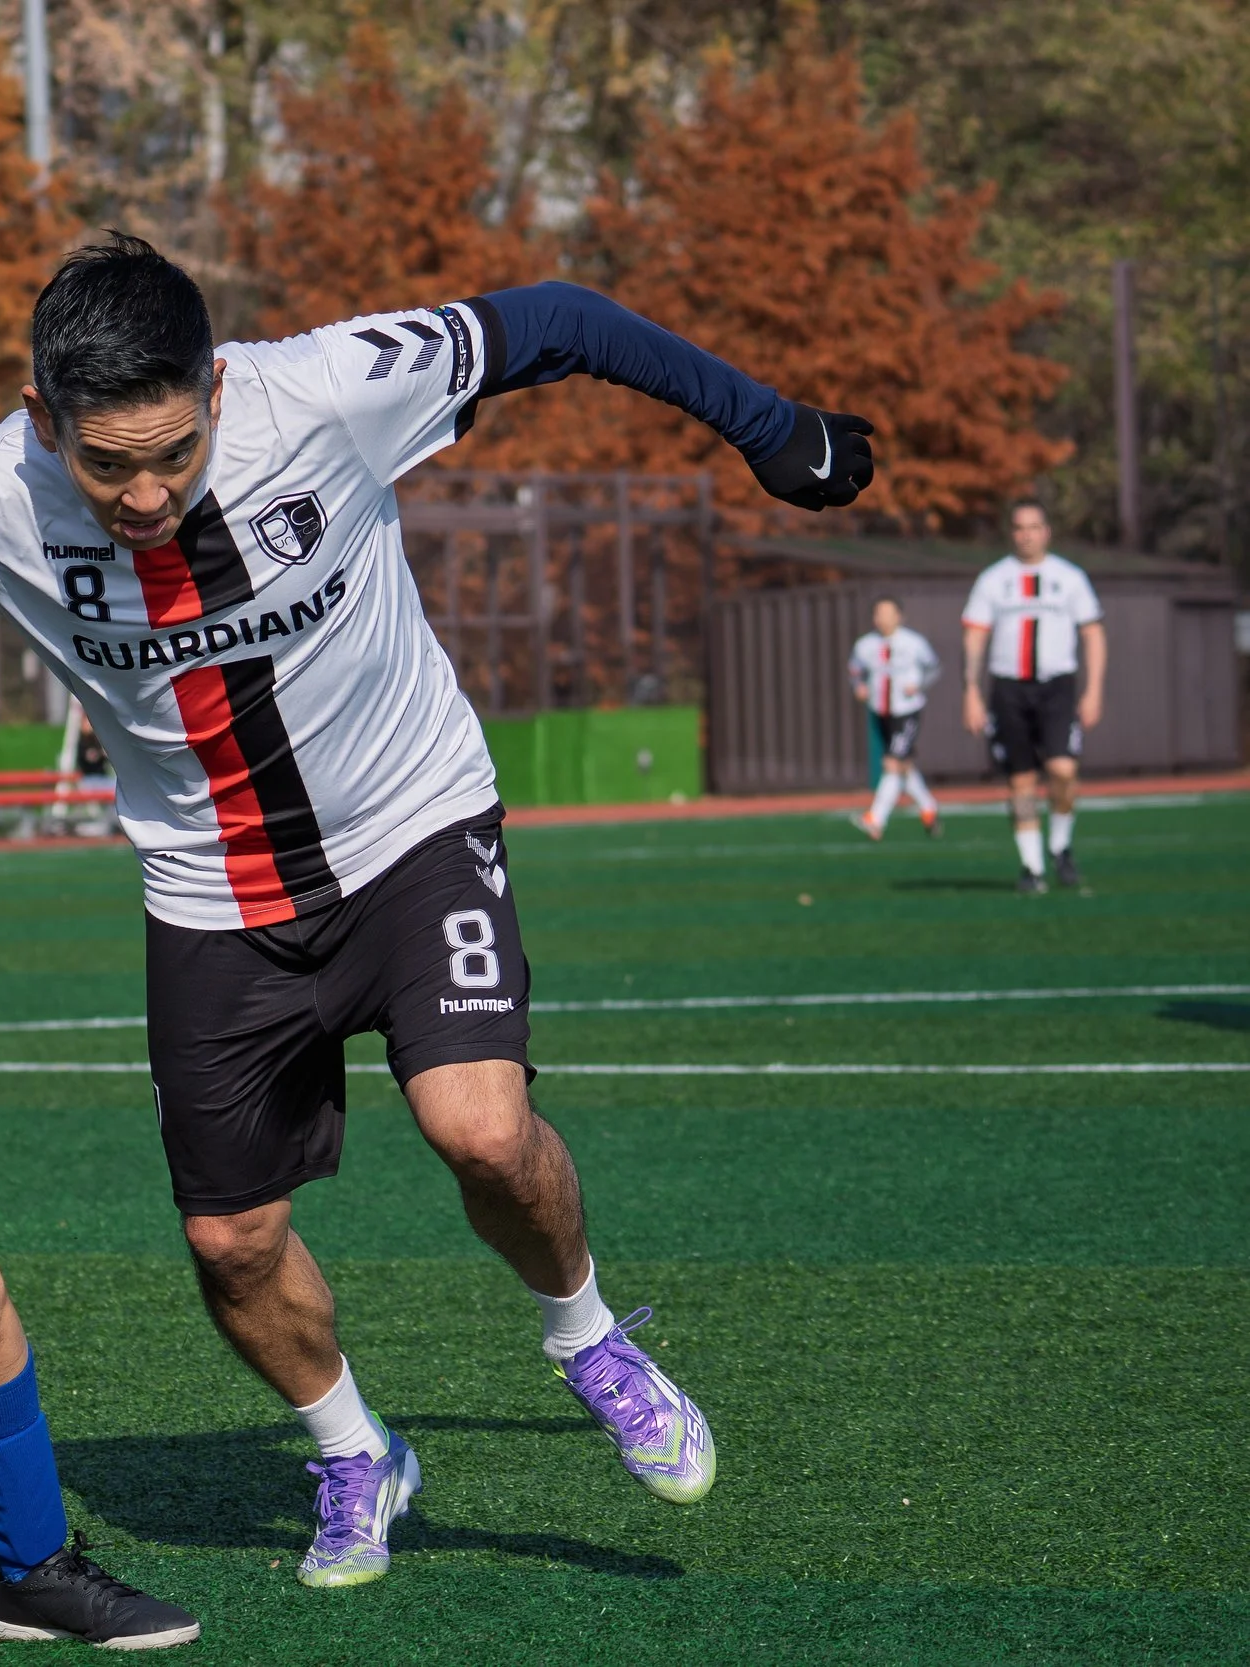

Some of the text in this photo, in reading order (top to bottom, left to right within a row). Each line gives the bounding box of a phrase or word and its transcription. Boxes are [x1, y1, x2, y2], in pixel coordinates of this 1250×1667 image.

[445, 314, 467, 390] RESPECT
[43, 541, 116, 561] hummel
[63, 565, 111, 622] 8
[72, 567, 347, 671] GUARDIANS
[442, 908, 501, 989] 8
[440, 997, 515, 1014] hummel
